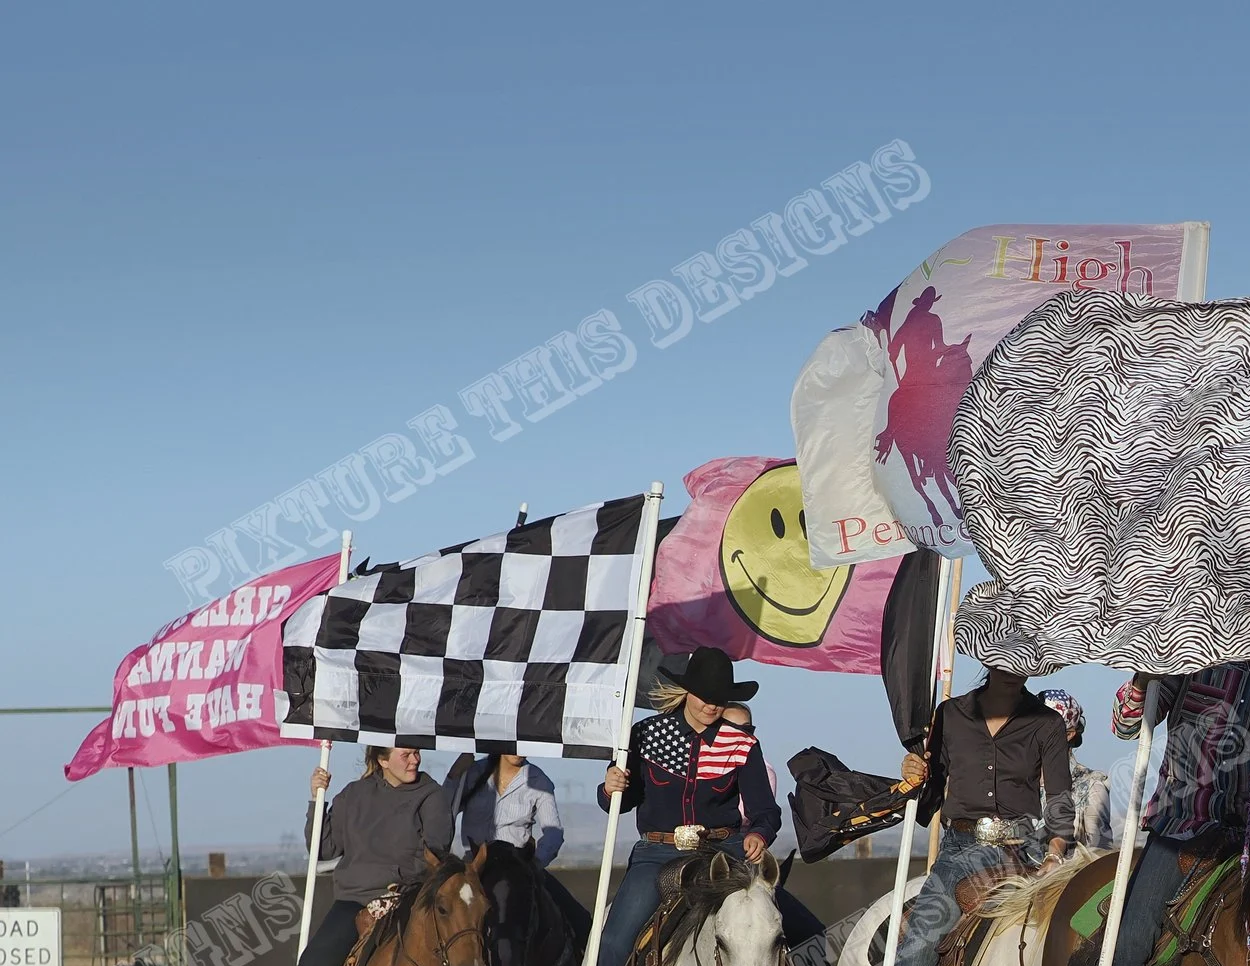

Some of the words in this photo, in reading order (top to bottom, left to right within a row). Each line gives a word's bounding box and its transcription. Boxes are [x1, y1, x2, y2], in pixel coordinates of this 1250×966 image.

[985, 235, 1154, 297] High
[0, 920, 39, 938] OAD
[0, 947, 51, 966] OSED
